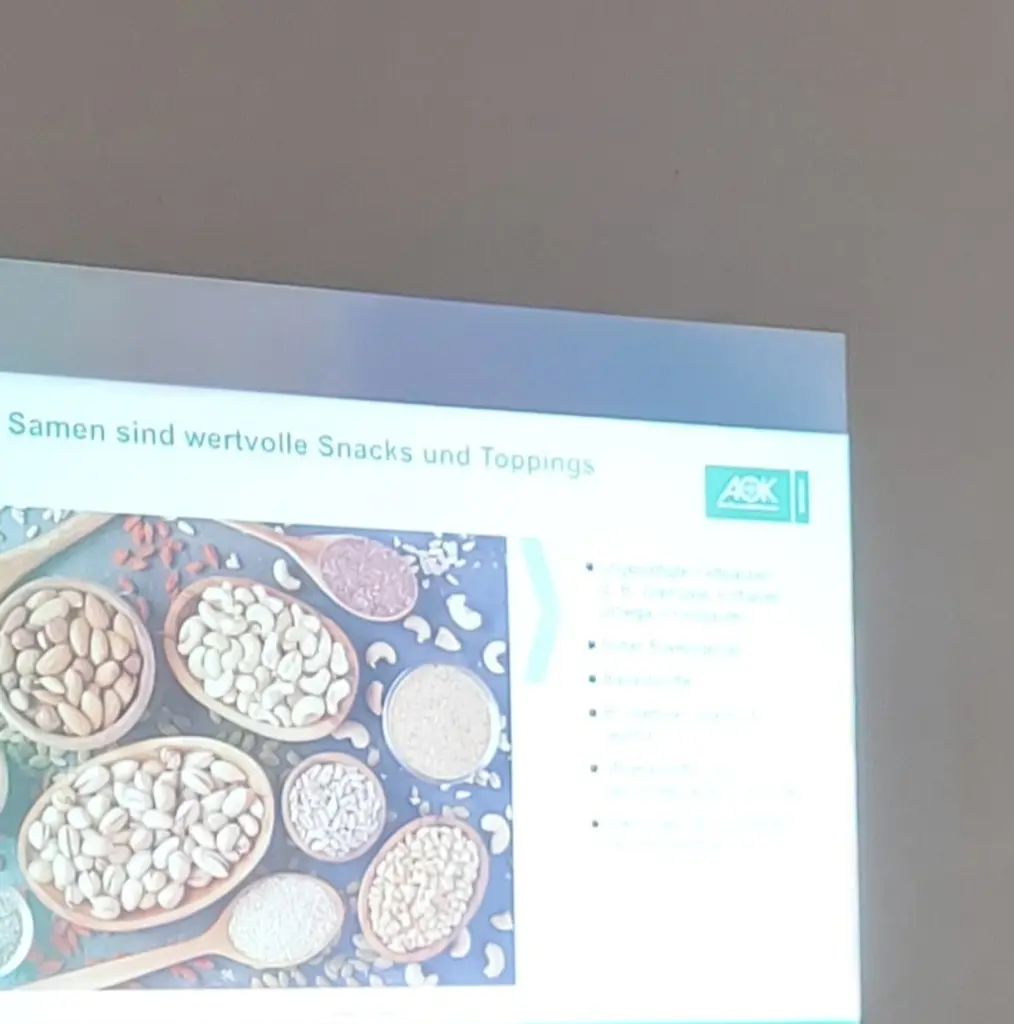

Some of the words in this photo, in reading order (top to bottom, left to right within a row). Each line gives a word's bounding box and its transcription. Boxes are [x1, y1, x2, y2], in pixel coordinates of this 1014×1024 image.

[8, 411, 106, 441] Samen
[116, 421, 175, 446] sind
[184, 430, 308, 455] wertvolle
[318, 434, 413, 463] Snacks
[423, 445, 470, 466] und
[480, 446, 596, 479] Toppings
[716, 474, 780, 507] AOK
